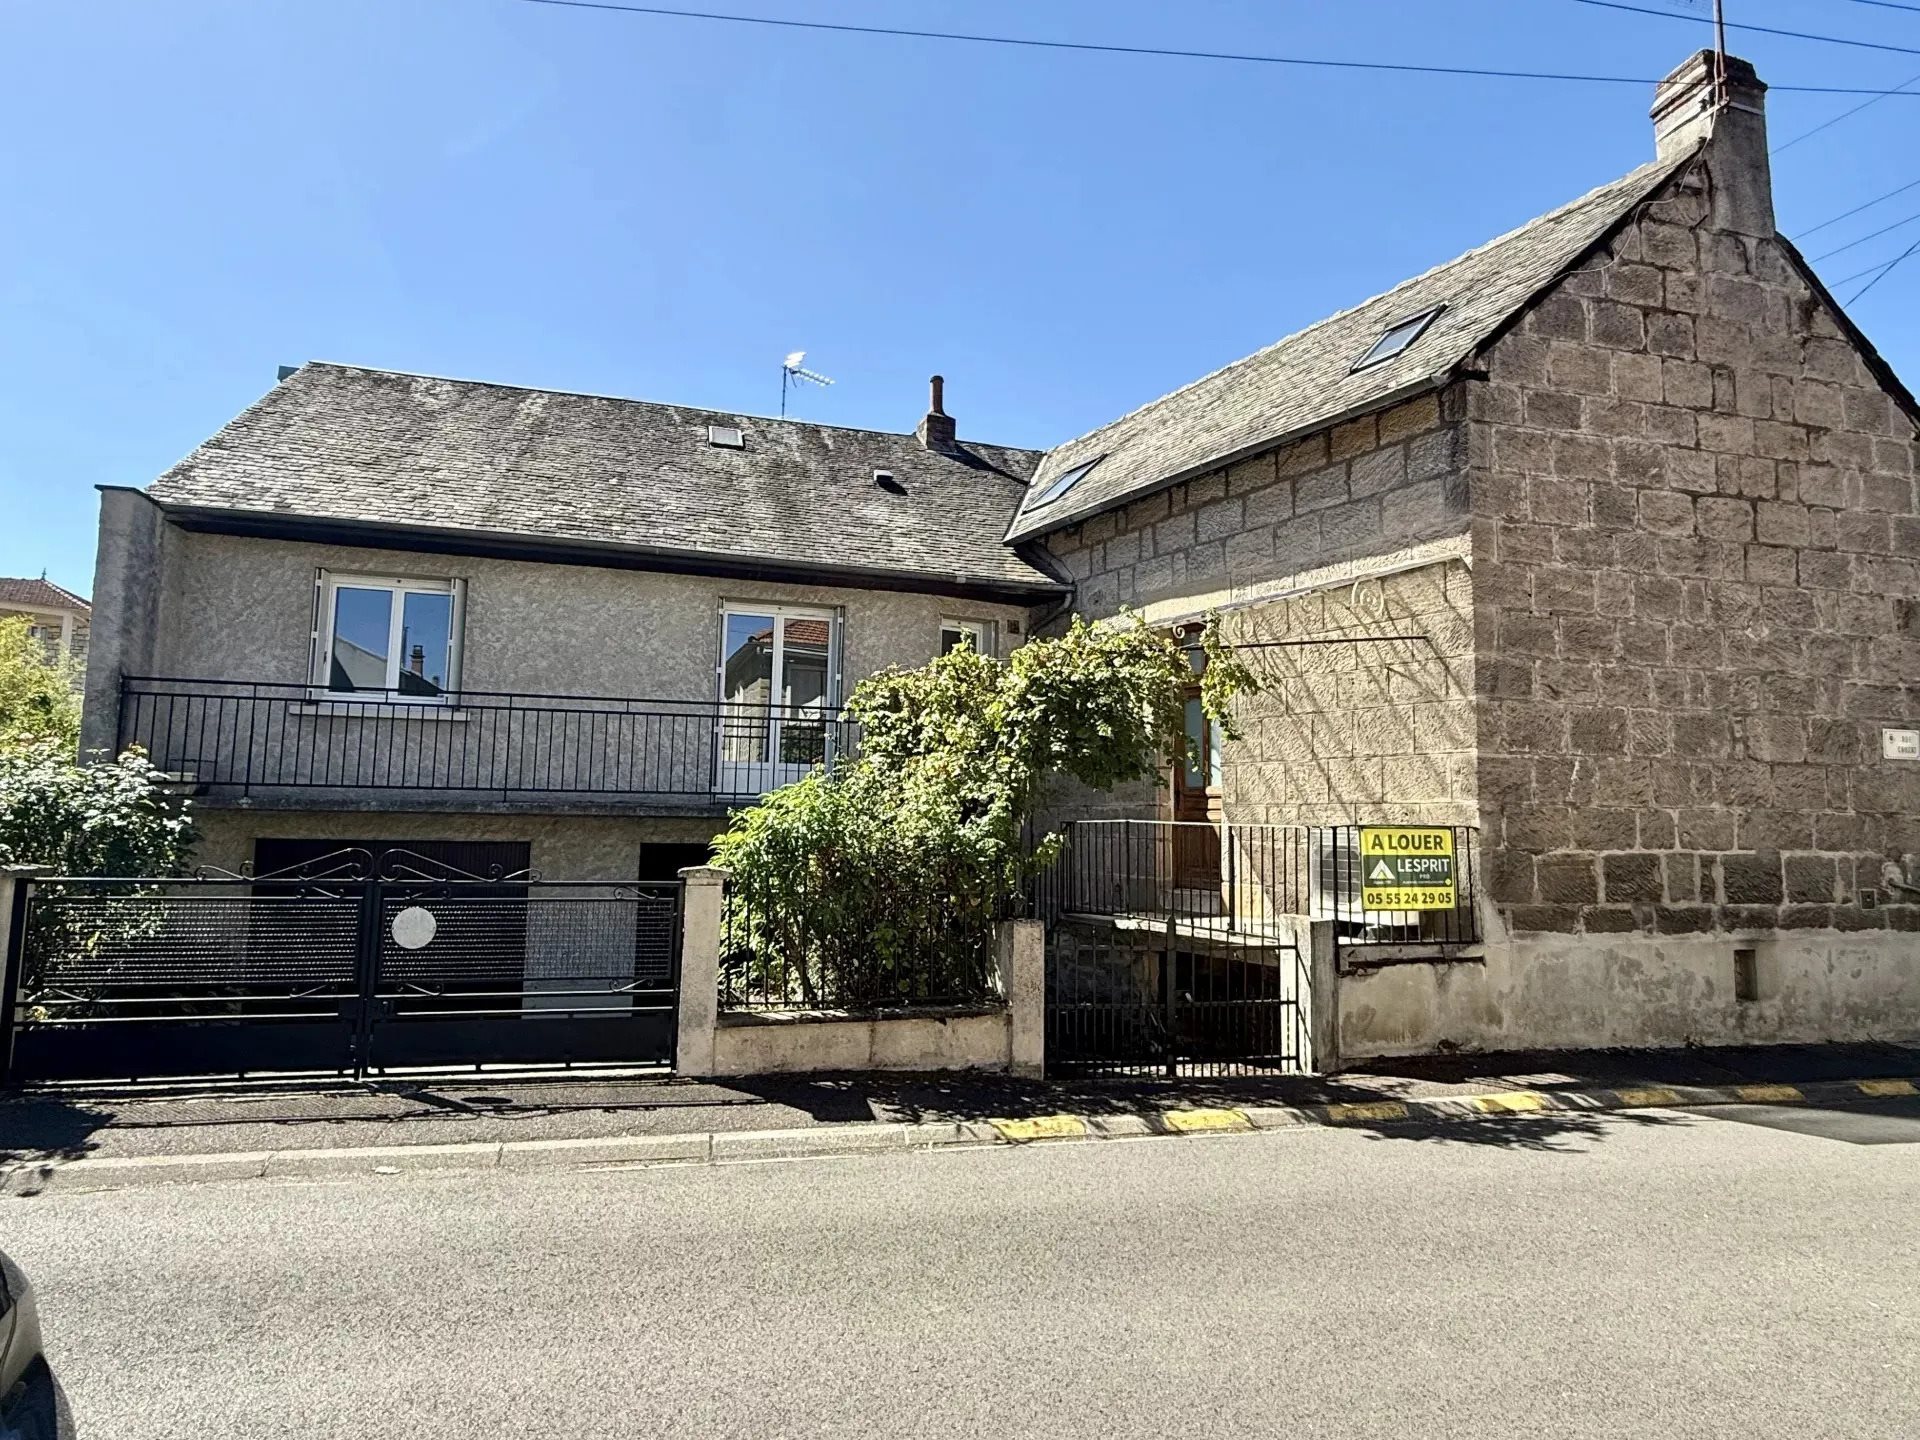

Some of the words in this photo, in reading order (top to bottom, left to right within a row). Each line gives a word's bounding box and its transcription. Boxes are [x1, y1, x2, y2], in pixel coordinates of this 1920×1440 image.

[1371, 834, 1384, 850] A
[1388, 834, 1444, 850] LOUER
[1397, 858, 1450, 872] LESPRIT
[1367, 893, 1383, 904] 05
[1386, 893, 1400, 904] 55
[1404, 893, 1418, 904] 24
[1421, 892, 1435, 904] 29
[1438, 892, 1452, 904] 05
